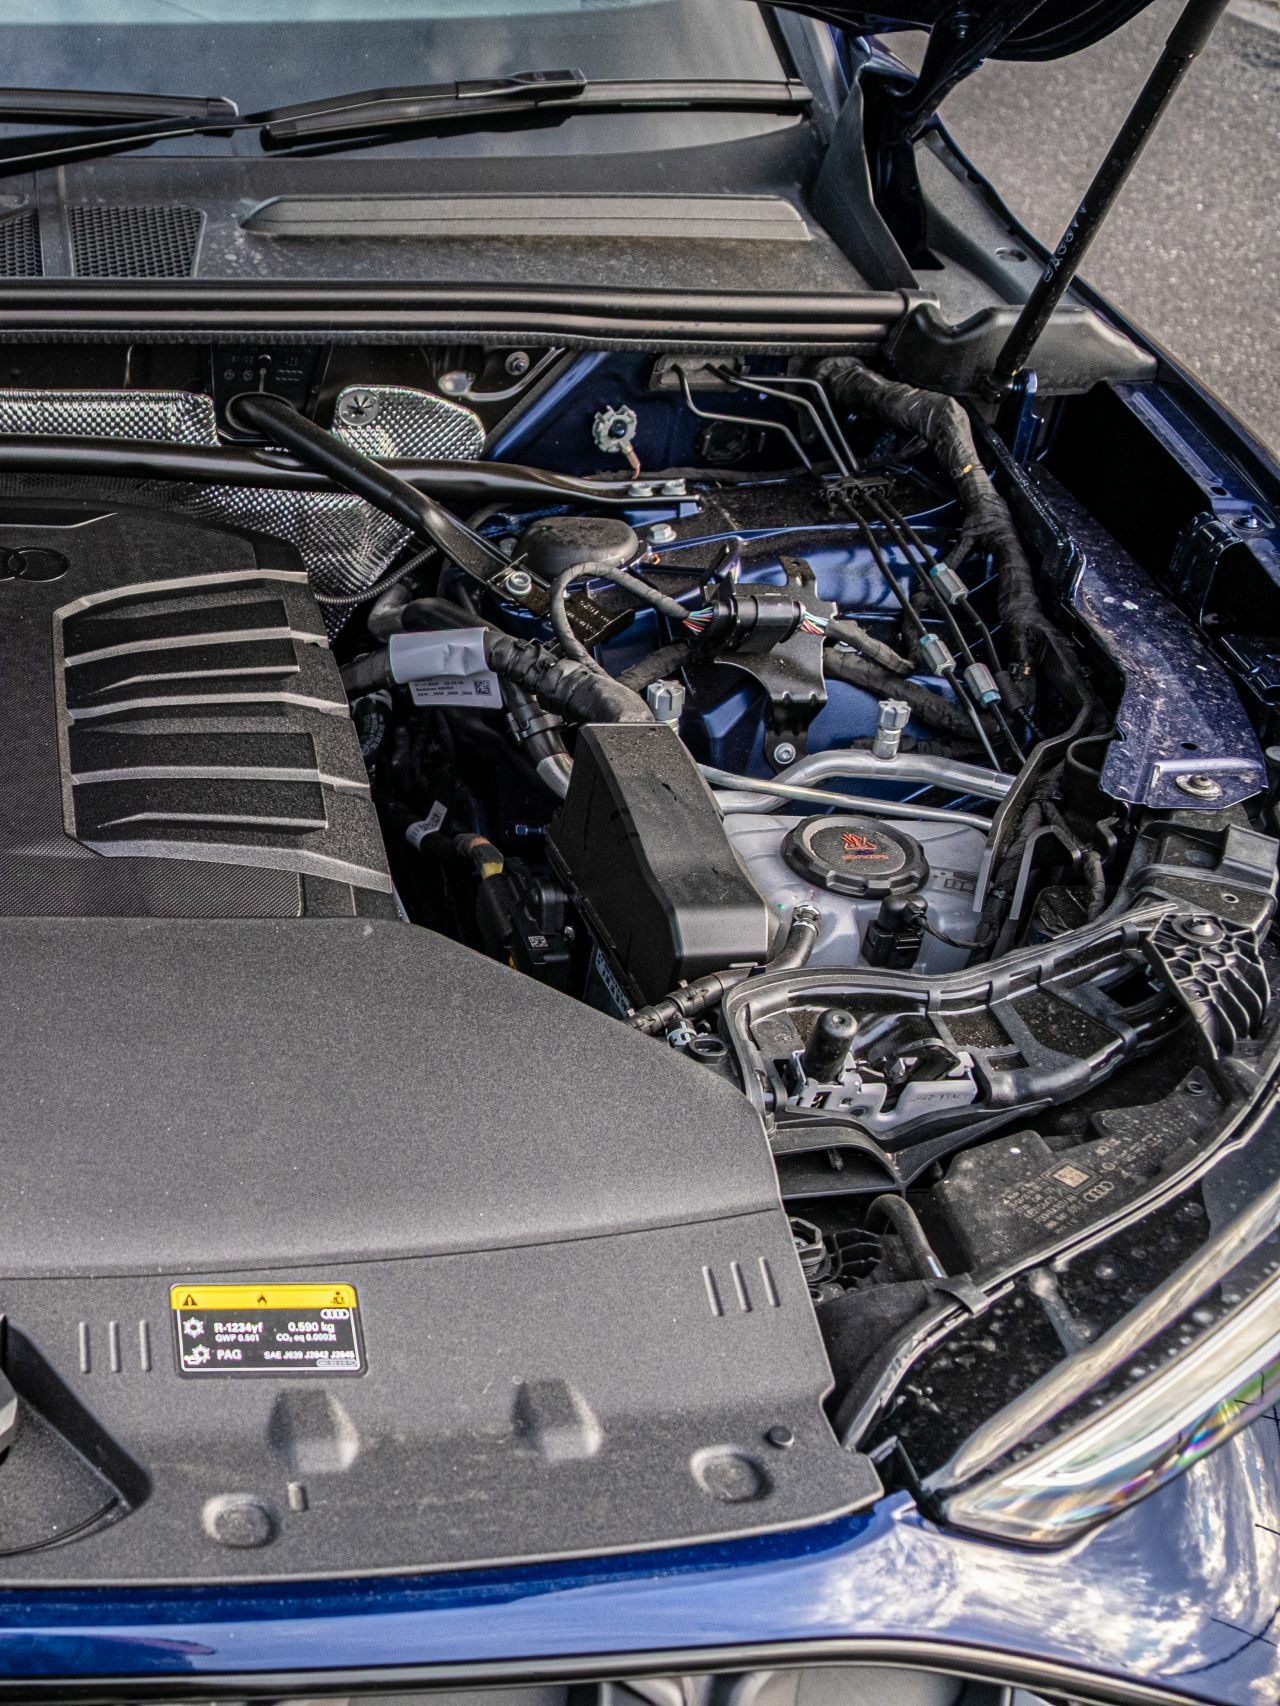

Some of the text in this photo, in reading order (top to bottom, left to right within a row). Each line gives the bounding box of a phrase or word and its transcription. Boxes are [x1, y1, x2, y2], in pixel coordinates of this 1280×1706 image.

[213, 1322, 264, 1334] R-1234yf
[287, 1321, 335, 1334] 0.590 kg
[215, 1334, 237, 1342] GWP
[216, 1349, 242, 1360] PAG
[264, 1351, 282, 1360] SAE
